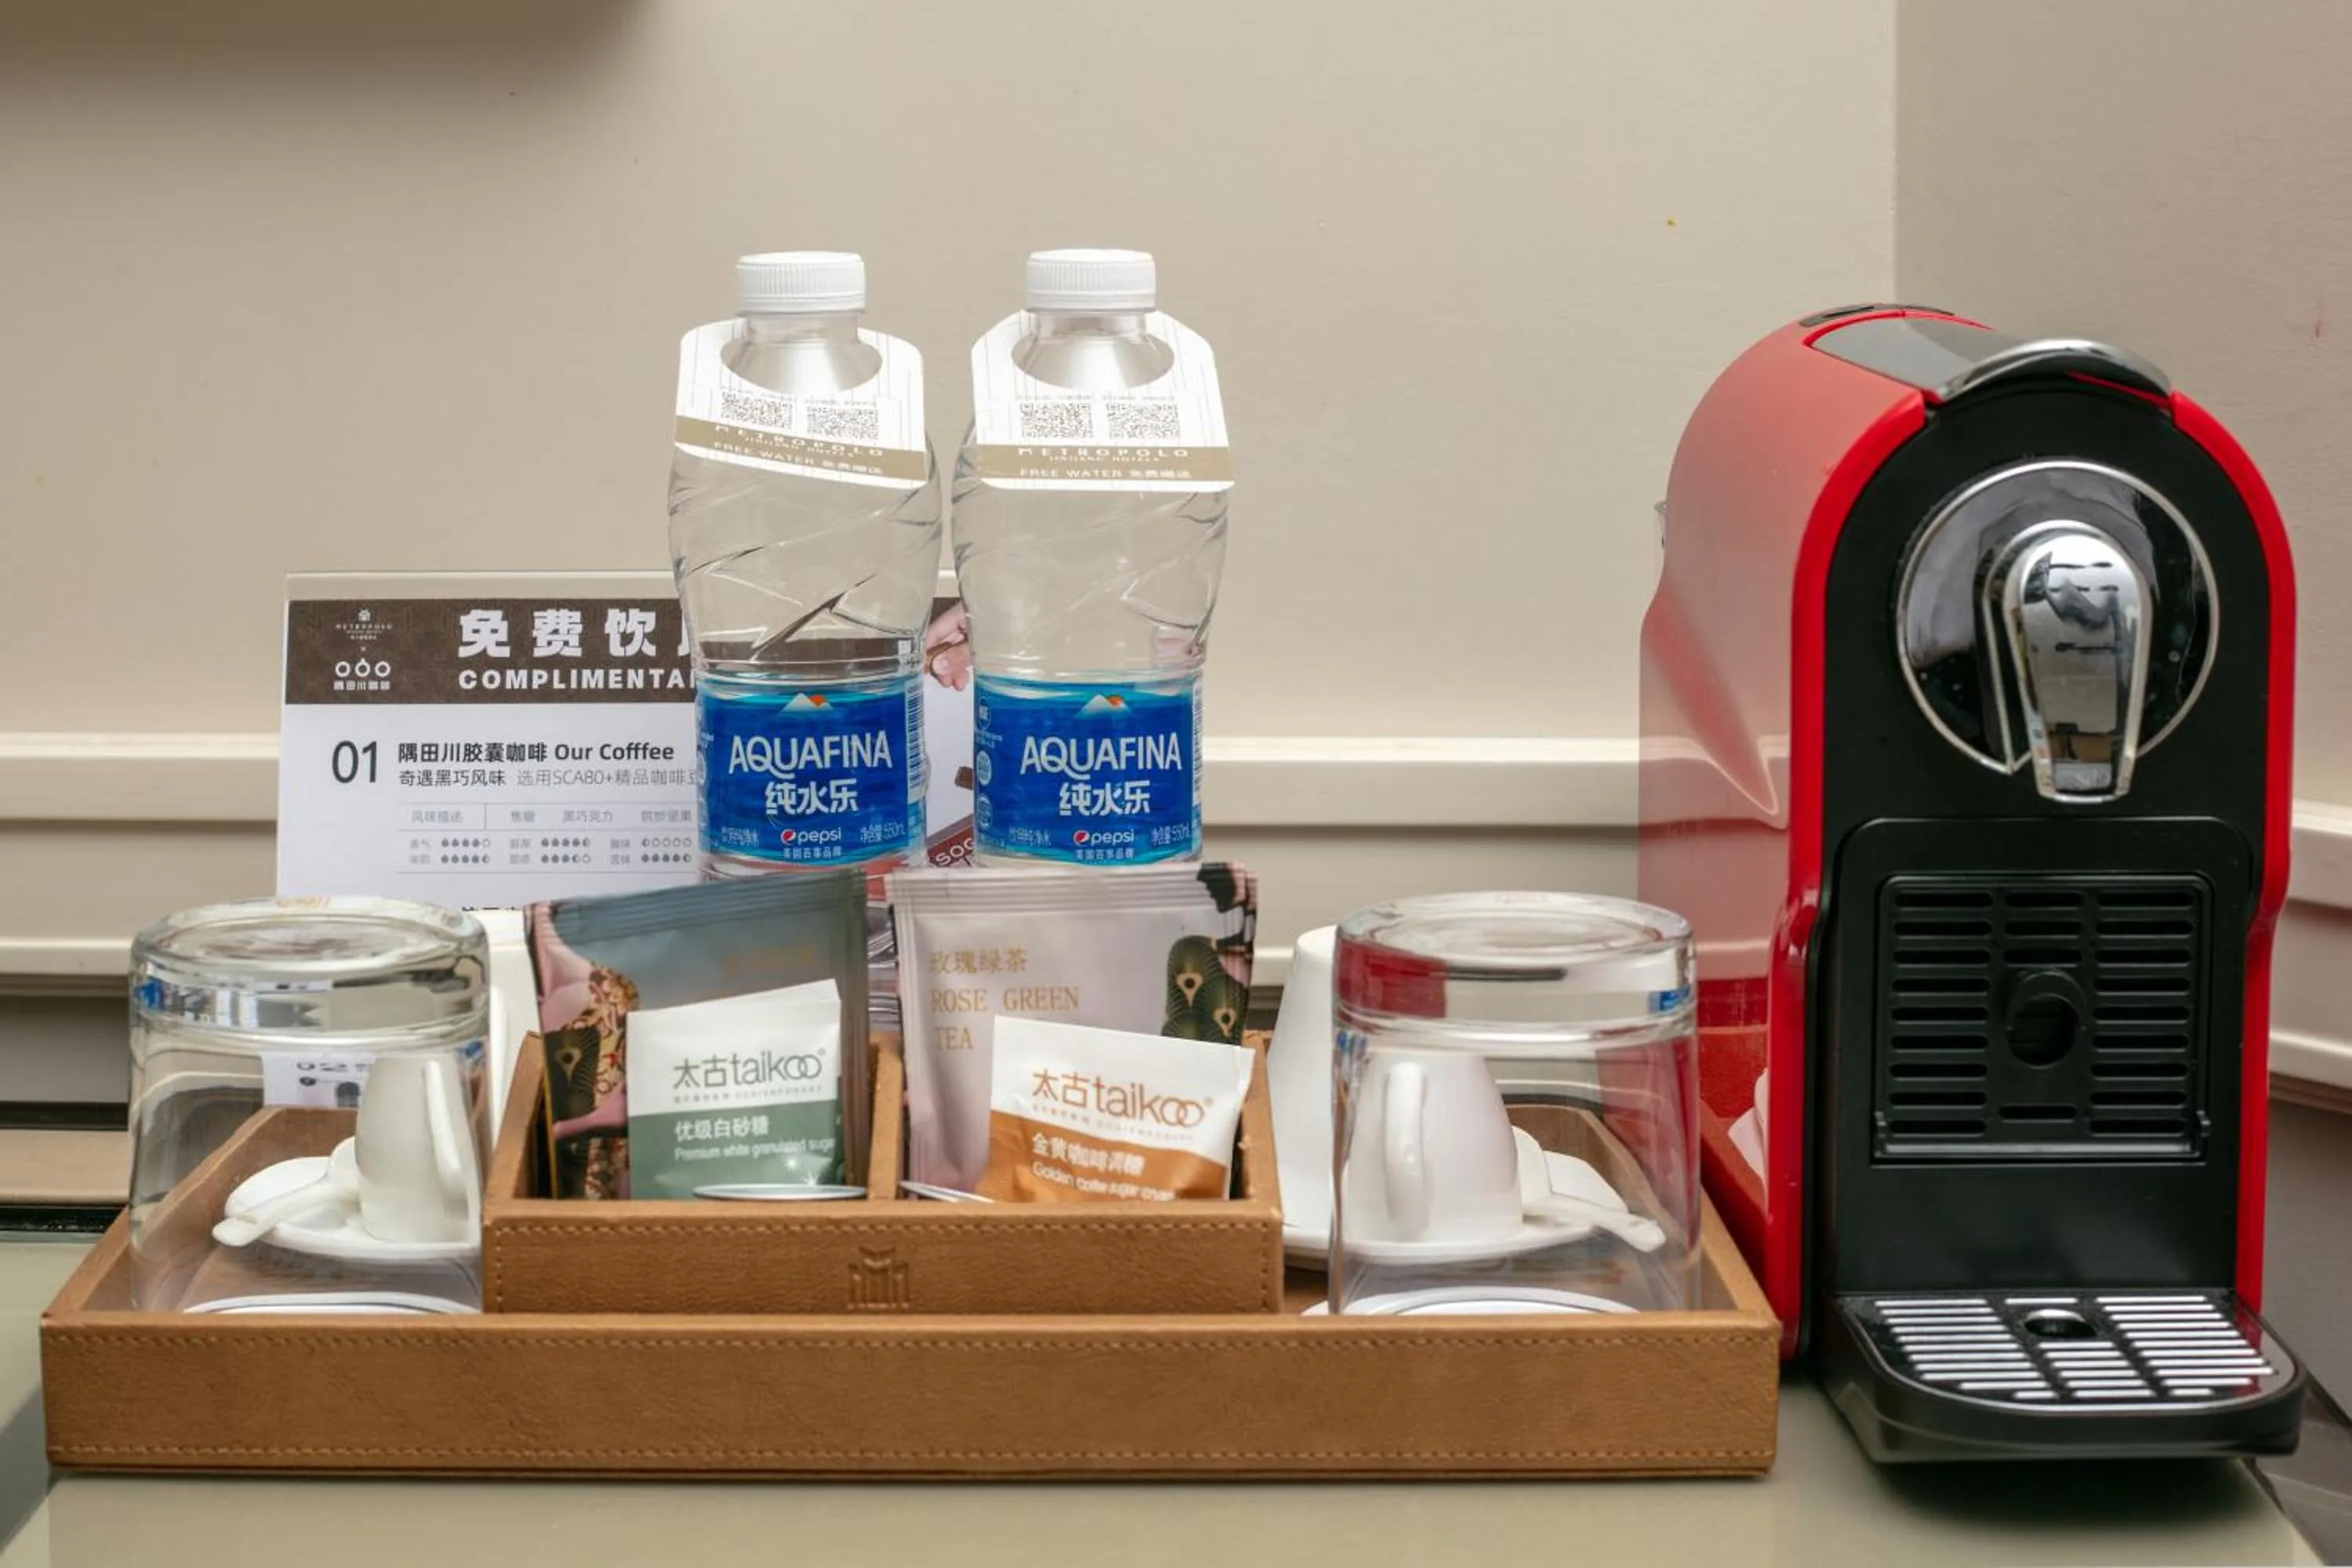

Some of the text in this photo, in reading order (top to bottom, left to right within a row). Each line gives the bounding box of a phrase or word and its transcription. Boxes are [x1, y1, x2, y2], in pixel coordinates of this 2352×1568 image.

[714, 441, 753, 455] FREE
[760, 450, 815, 465] WATER
[1018, 447, 1189, 458] METROPOLO
[1020, 469, 1059, 477] FREE
[1066, 470, 1122, 478] WATER
[459, 608, 690, 656] 免费饮
[459, 669, 695, 689] COMPLIMENTA
[332, 741, 376, 783] 01
[398, 742, 674, 763] 隅田川胶囊咖啡 Our Cofffee
[728, 730, 893, 780] AQUAFINA
[1020, 731, 1183, 780] AQUAFINA
[399, 769, 507, 786] 奇遇黑巧风味
[765, 778, 859, 815] 纯水乐
[1059, 779, 1151, 816] 纯水乐
[797, 828, 842, 845] pepsi
[1091, 829, 1134, 847] pepsi
[929, 947, 1029, 974] 玫瑰绿茶
[931, 985, 1080, 1012] ROSE GREEN
[934, 1026, 975, 1051] TEA
[674, 1115, 768, 1142] 优级白砂糖
